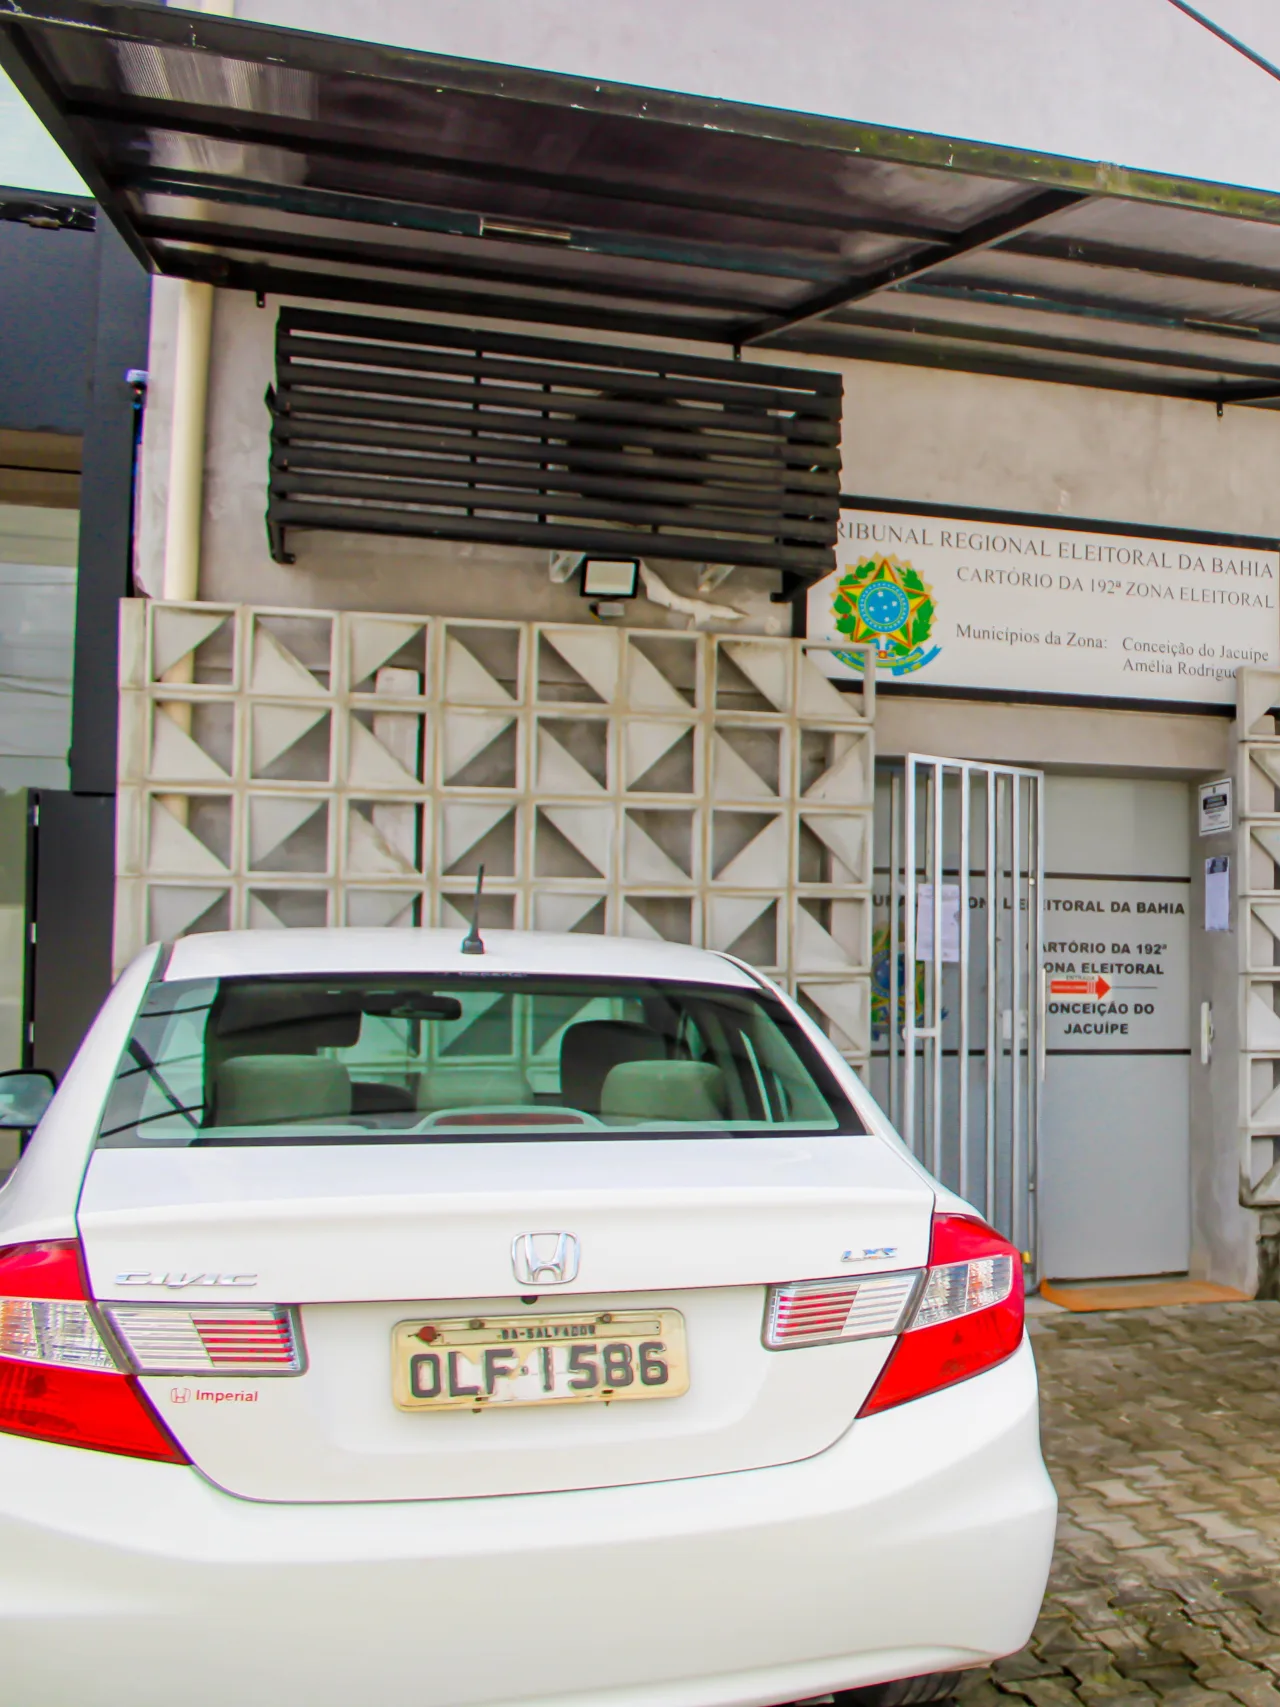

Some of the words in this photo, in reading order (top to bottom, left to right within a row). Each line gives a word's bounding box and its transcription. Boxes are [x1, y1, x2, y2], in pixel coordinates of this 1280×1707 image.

[837, 521, 934, 546] RIBUNAL
[940, 529, 1052, 557] REGIONAL
[1058, 541, 1173, 569] ELEITORAL
[1178, 554, 1206, 573] DA
[1212, 557, 1274, 579] BAHIA
[956, 566, 1053, 587] CARTÓRIO
[1059, 575, 1084, 592] DA
[1090, 578, 1122, 595] 192ª
[1125, 581, 1175, 600] ZONA
[1180, 586, 1275, 609] ELEITORAL
[956, 623, 1040, 646] Municípios
[1044, 631, 1062, 645] da
[1066, 632, 1108, 650] Zona:
[1122, 636, 1195, 657] Conceição
[1198, 643, 1215, 657] do
[1122, 658, 1173, 675] Amélia
[1020, 898, 1106, 913] EITORAL
[1110, 901, 1131, 913] DA
[1136, 902, 1185, 914] BAHIA
[1111, 943, 1131, 954] DA
[1136, 944, 1168, 955] 192ª
[1043, 962, 1076, 973] ONA
[1081, 962, 1165, 975] ELEITORAL
[1046, 1001, 1129, 1017] ONCEIÇÃO
[1134, 1003, 1155, 1015] DO
[1063, 1021, 1129, 1035] JACUÍPE
[114, 1271, 258, 1289] CIVIC
[195, 1389, 259, 1404] Imperial
